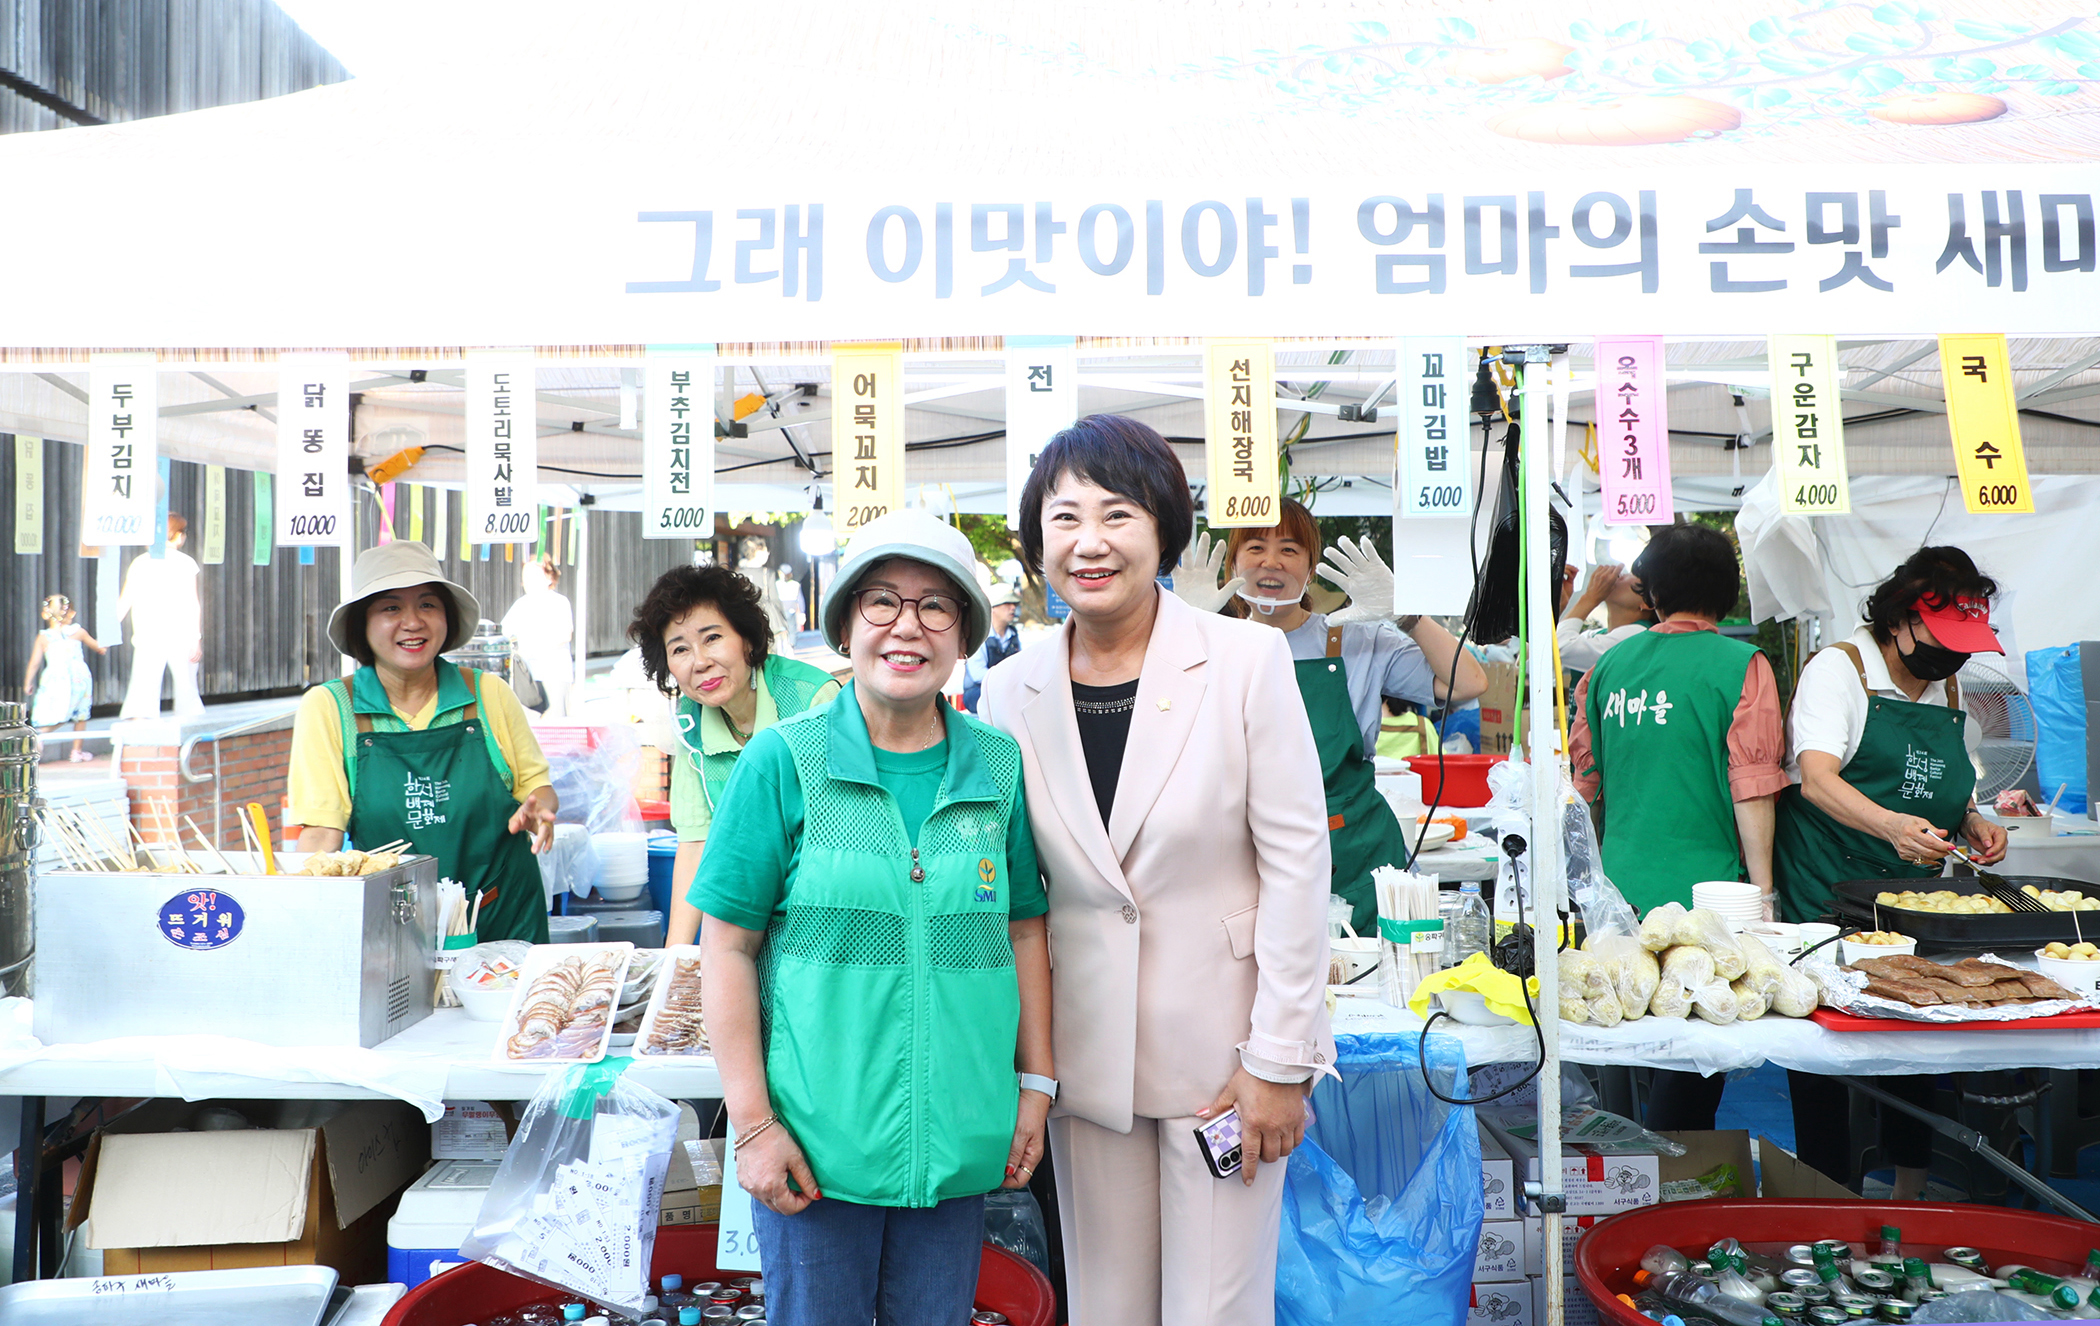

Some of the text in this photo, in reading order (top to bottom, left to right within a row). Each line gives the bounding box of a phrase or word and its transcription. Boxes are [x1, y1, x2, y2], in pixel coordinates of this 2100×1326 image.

[625, 203, 824, 303] 그래
[865, 197, 1313, 299] 이맛이야!
[1356, 190, 1660, 295] 엄마의
[1698, 188, 1902, 294] 손맛
[1229, 358, 1254, 483] 선지해장국
[1421, 353, 1449, 472] 꼬마김밥
[1616, 355, 1643, 480] 옥수수3개
[1790, 352, 1822, 469] 구운감자
[110, 383, 134, 499] 두부김치
[493, 373, 515, 507] 도토리묵사발
[669, 370, 692, 494] 부추김치전
[853, 372, 877, 491] 어묵꼬치
[1225, 495, 1271, 519] 8,000
[1418, 485, 1463, 509] 5,000
[1618, 492, 1656, 517] 5,000
[1794, 484, 1838, 506] 4,000
[1978, 484, 2018, 506] 6,000
[97, 514, 143, 534] 10,000
[290, 514, 336, 536] 10,000
[484, 512, 530, 535] 8,000
[660, 507, 705, 530] 5,000
[1603, 687, 1674, 728] 새마을
[1905, 743, 1928, 773] 한성
[403, 771, 434, 798] 한성
[405, 808, 446, 830] 문화제
[187, 892, 217, 912] 앗!
[167, 911, 233, 928] 뜨거워
[1613, 1198, 1640, 1206] 서구식품
[1477, 1264, 1504, 1272] 서구식품
